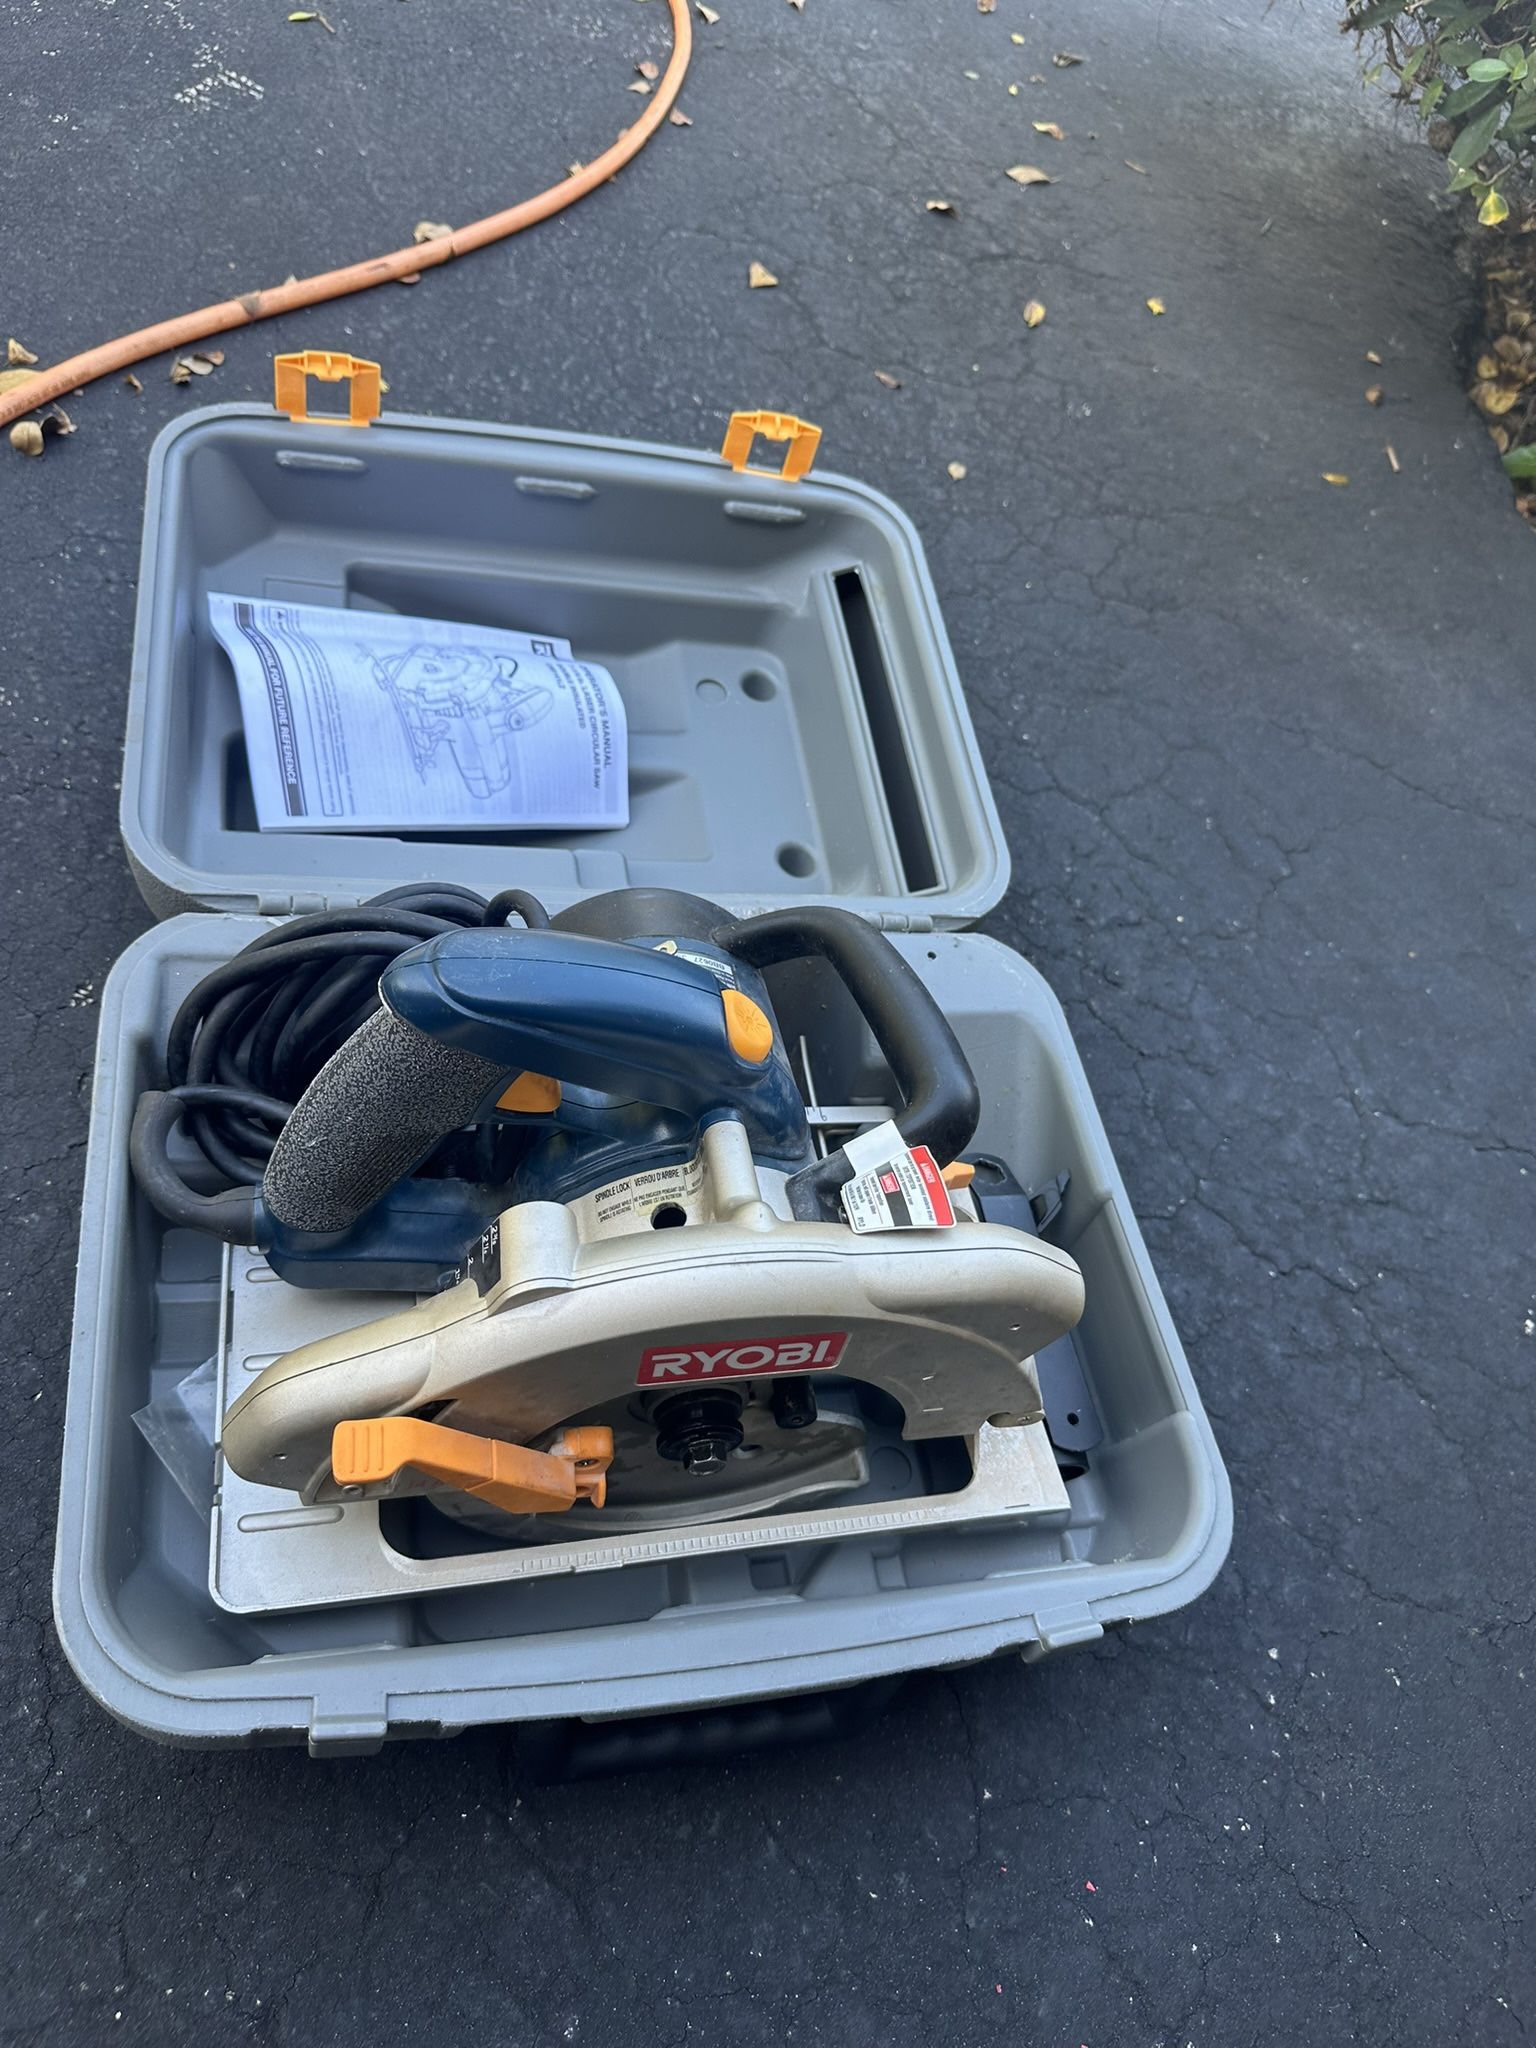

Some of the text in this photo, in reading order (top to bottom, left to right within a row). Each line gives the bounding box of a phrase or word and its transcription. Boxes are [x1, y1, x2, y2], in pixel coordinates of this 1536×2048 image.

[269, 668, 282, 690] FOR
[272, 690, 288, 727] FUTURE
[582, 686, 601, 790] LASER CIRCULAR SAW
[601, 720, 613, 769] MANUAL
[280, 728, 298, 786] REFERENCE
[595, 1181, 631, 1203] SPINDLE LOCK
[634, 1168, 680, 1187] VERROU D'ARBRE
[651, 1339, 831, 1377] RYOBI
